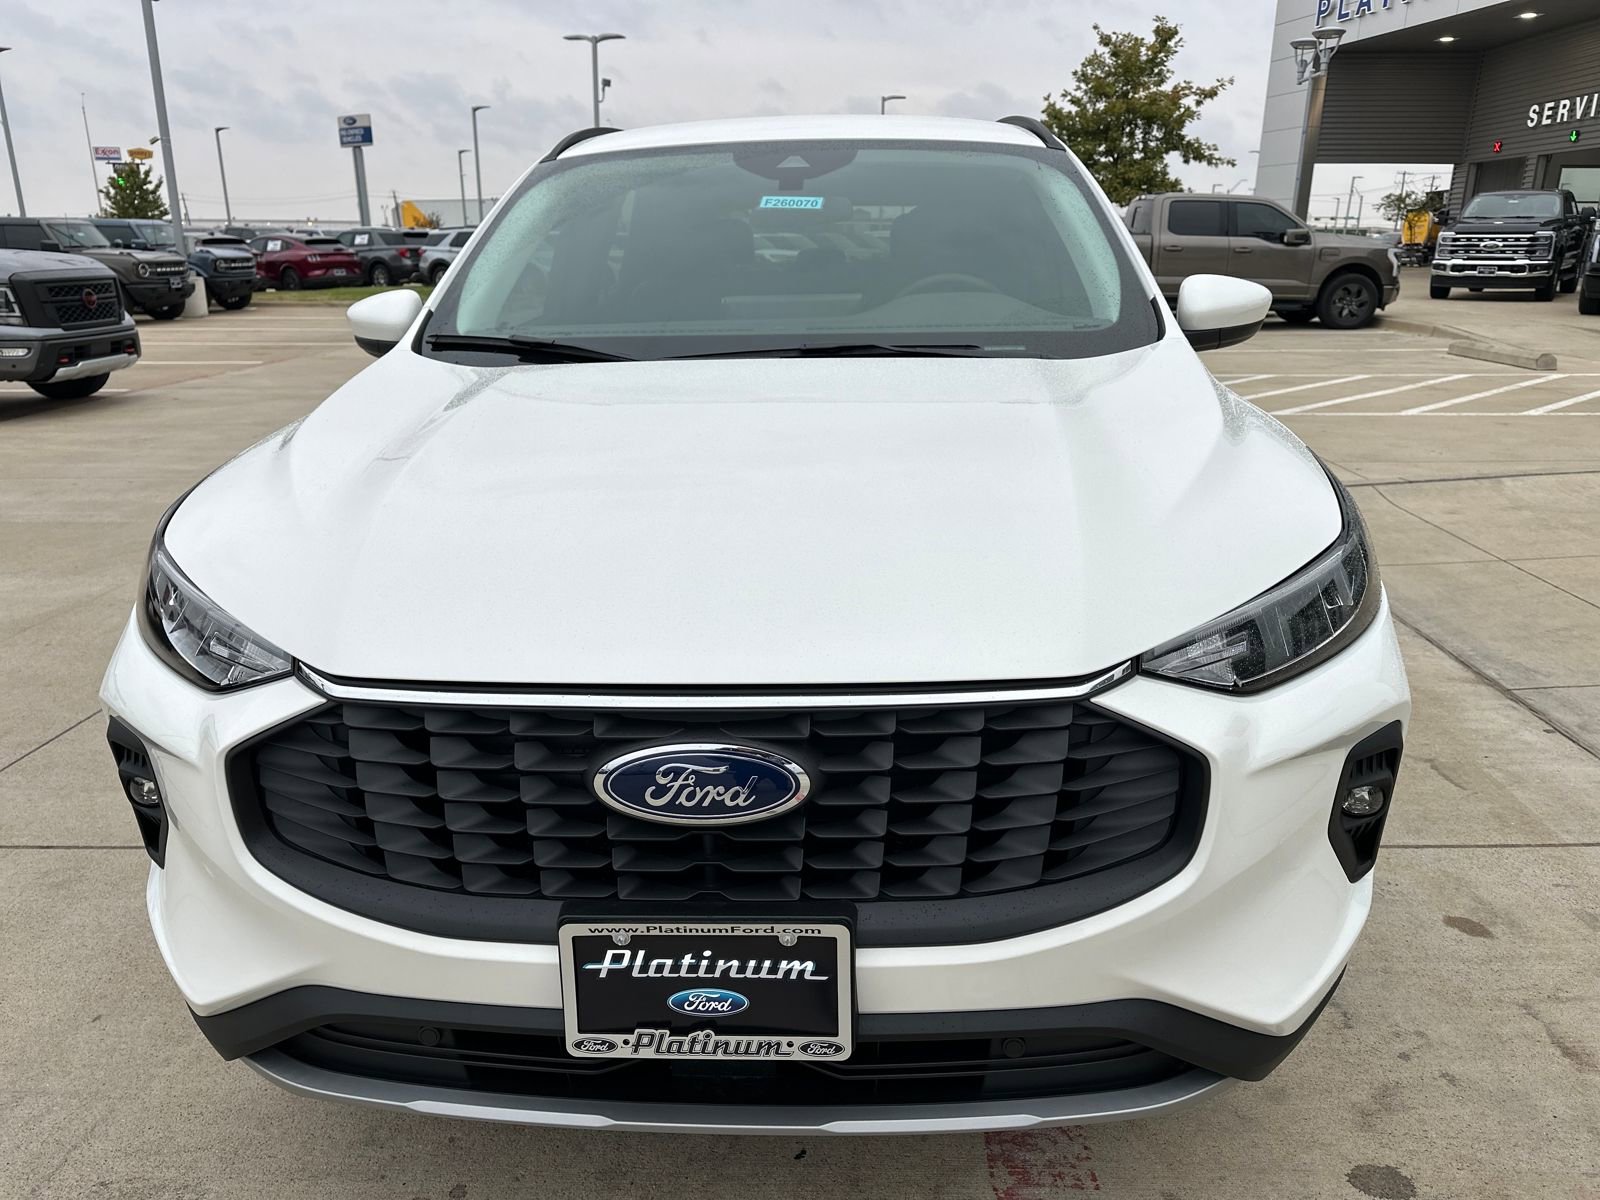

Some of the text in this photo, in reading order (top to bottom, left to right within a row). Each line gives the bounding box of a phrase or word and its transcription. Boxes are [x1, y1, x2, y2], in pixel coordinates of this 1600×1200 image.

[764, 198, 819, 208] F260070
[644, 763, 760, 807] Ford
[588, 926, 822, 935] www.PlatinumFord.com
[582, 949, 829, 980] Platinum
[684, 992, 733, 1011] Ford
[580, 1031, 837, 1057] Ford Platinum Ford
